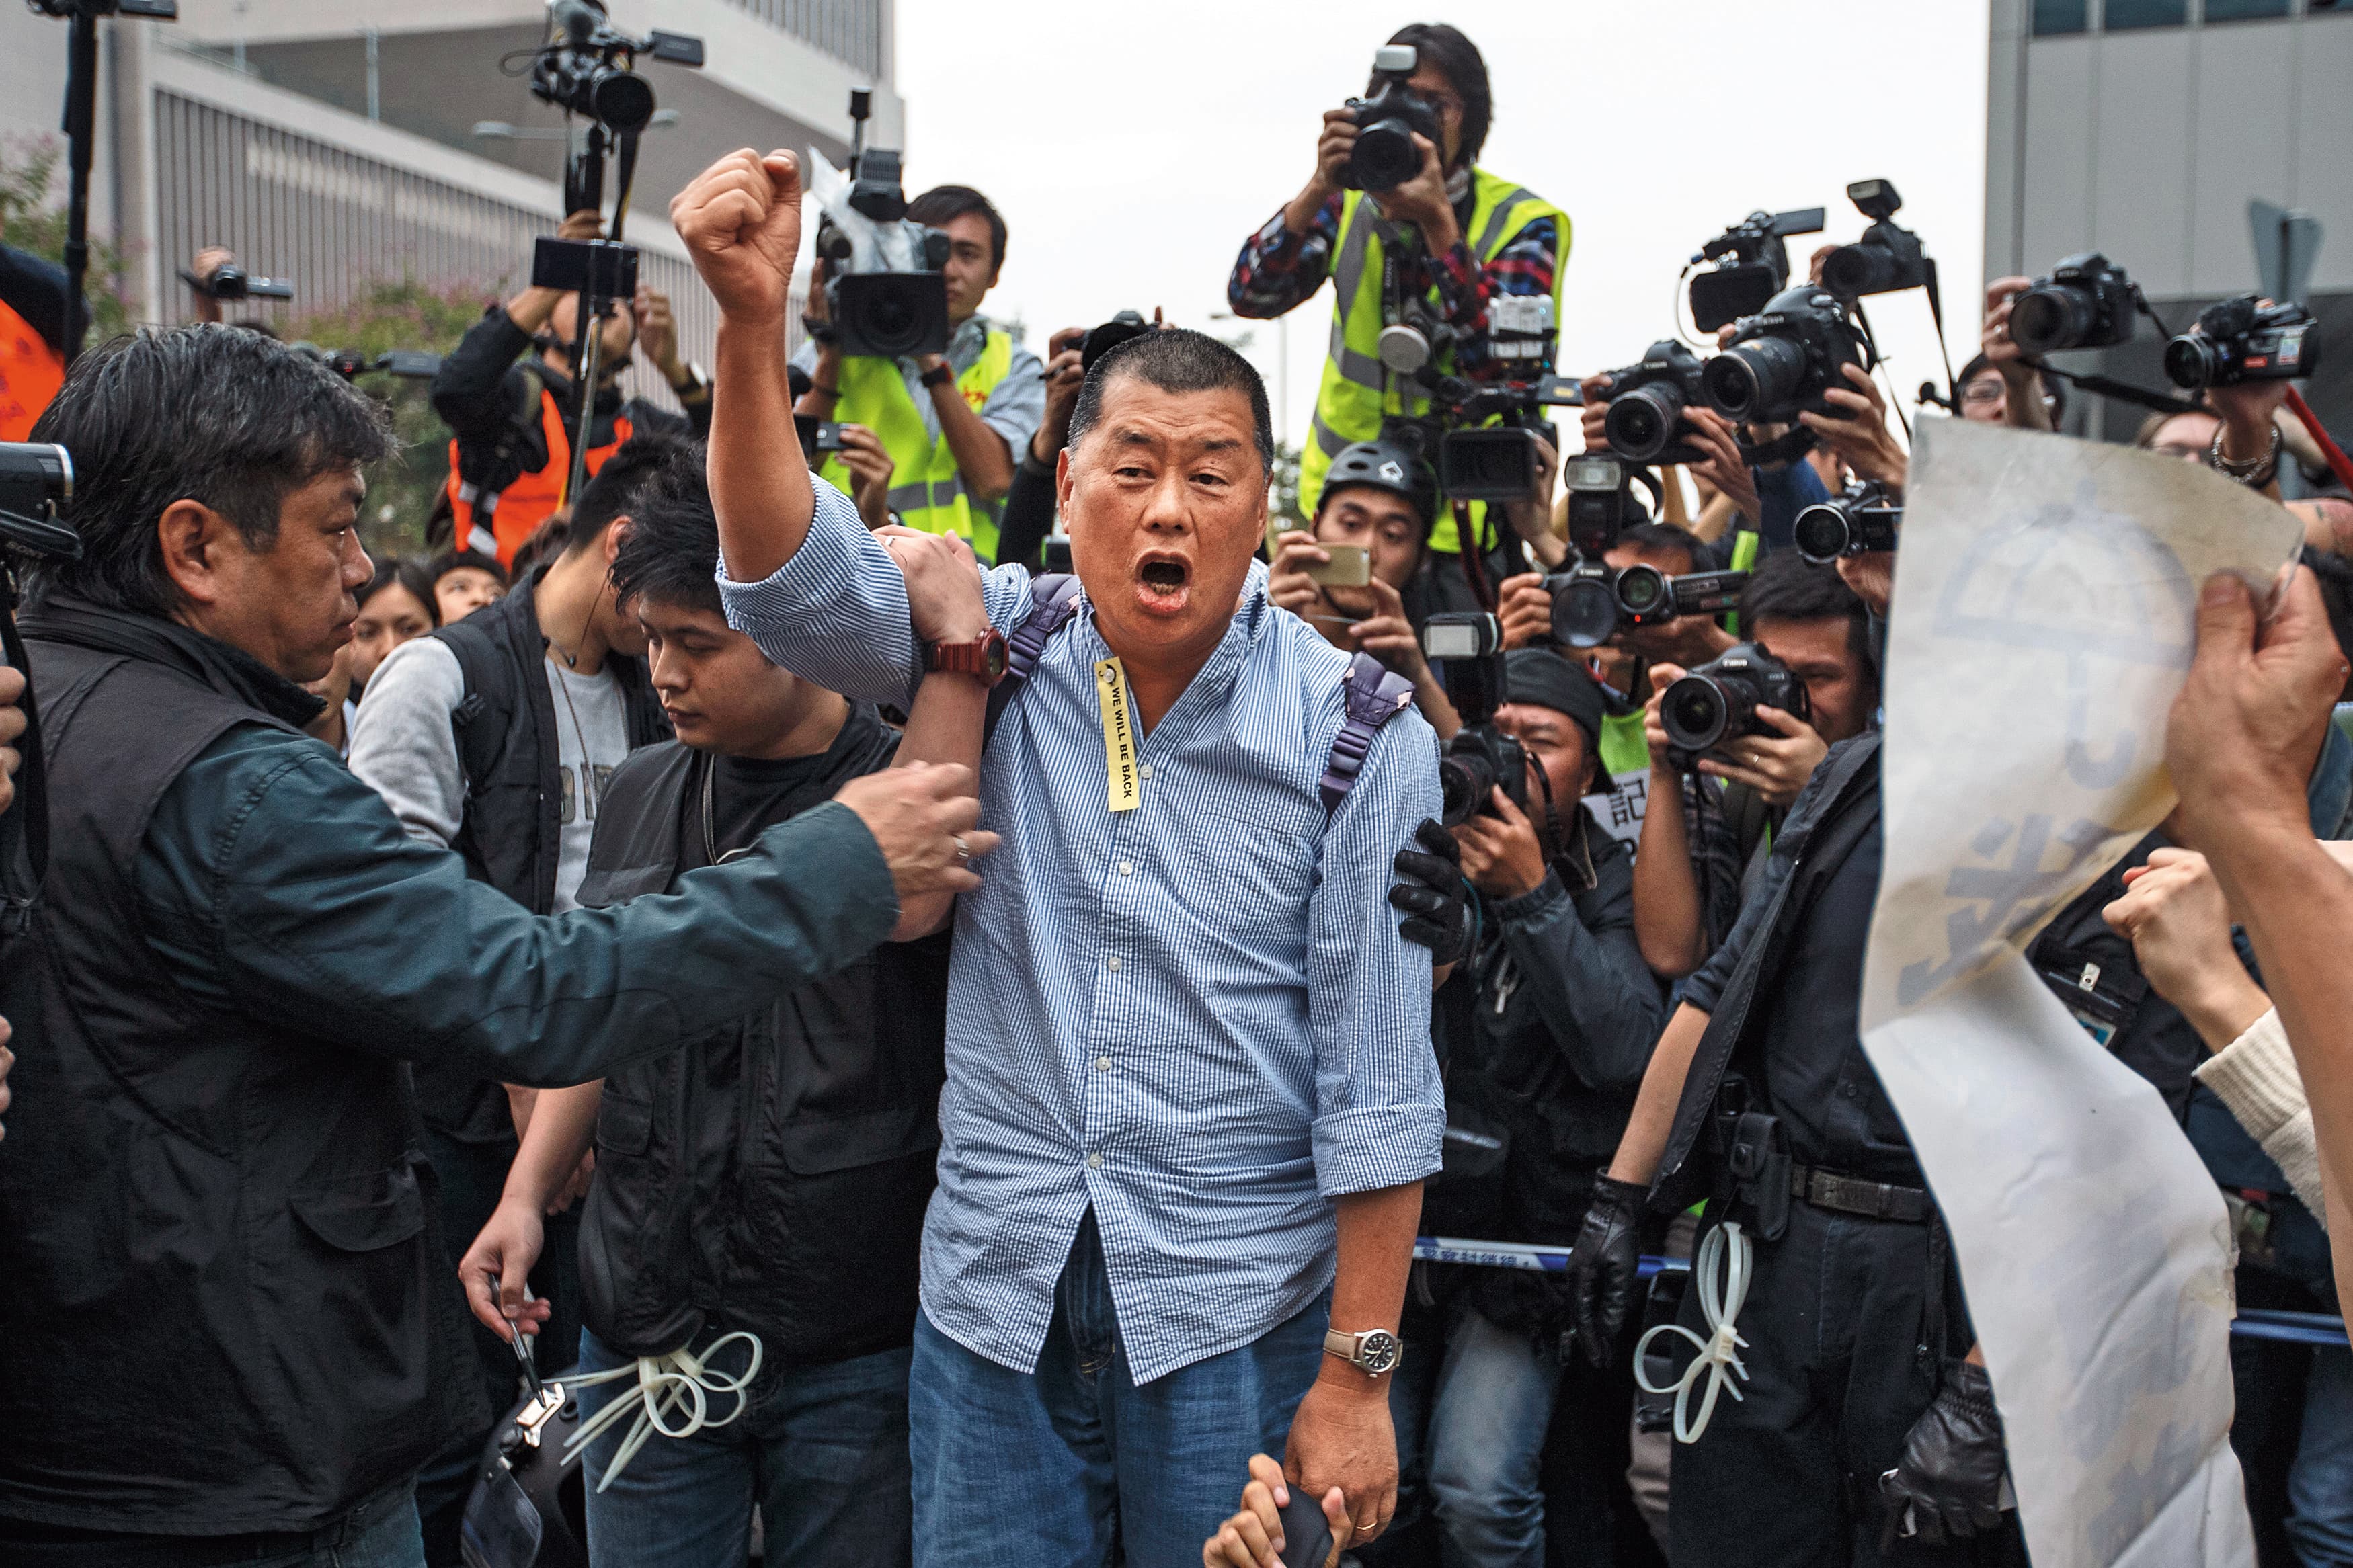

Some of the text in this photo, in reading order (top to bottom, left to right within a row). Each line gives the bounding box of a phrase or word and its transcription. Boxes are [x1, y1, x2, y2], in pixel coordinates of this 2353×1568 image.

[1722, 659, 1748, 667] Canon
[1112, 687, 1132, 798] WE WILL BE BACK
